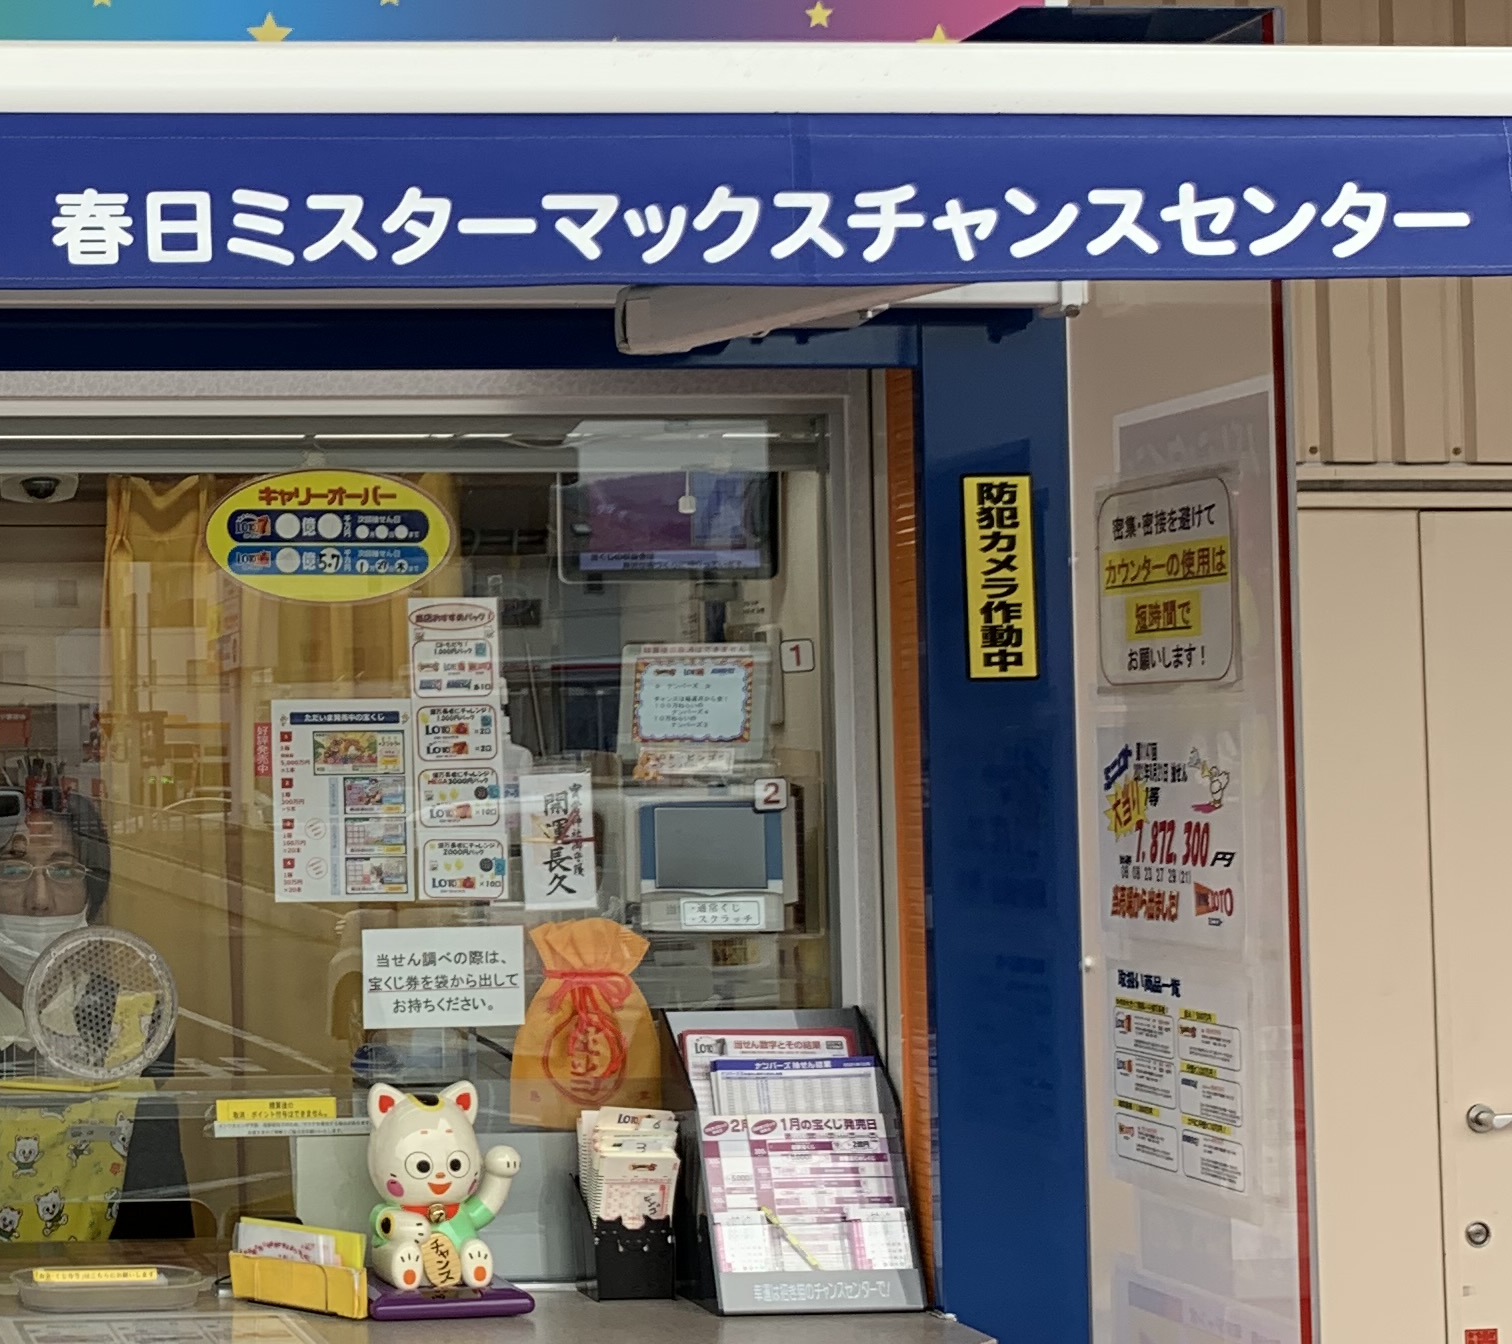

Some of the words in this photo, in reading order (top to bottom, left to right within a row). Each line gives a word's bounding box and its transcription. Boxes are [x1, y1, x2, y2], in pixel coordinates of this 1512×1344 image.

[50, 181, 1471, 267] 春日ミスターマックスチャンスセンター
[259, 485, 396, 506] キャリーオーバー
[1112, 503, 1216, 542] 密集・密接を避けて
[975, 481, 1024, 673] 防犯カメラ作動中
[1105, 545, 1227, 586] カウンターの使用は
[1134, 600, 1192, 632] 短時間で
[790, 645, 801, 666] 1
[1127, 645, 1207, 671] お願いします!
[763, 783, 781, 804] 2
[376, 949, 507, 969] 当せん調べの際は、
[368, 973, 519, 991] 宝くじ券を袋から出して
[393, 997, 495, 1014] お持ちください。
[780, 1118, 878, 1132] 1月の宝くじ発売日
[428, 1237, 456, 1283] チャンス
